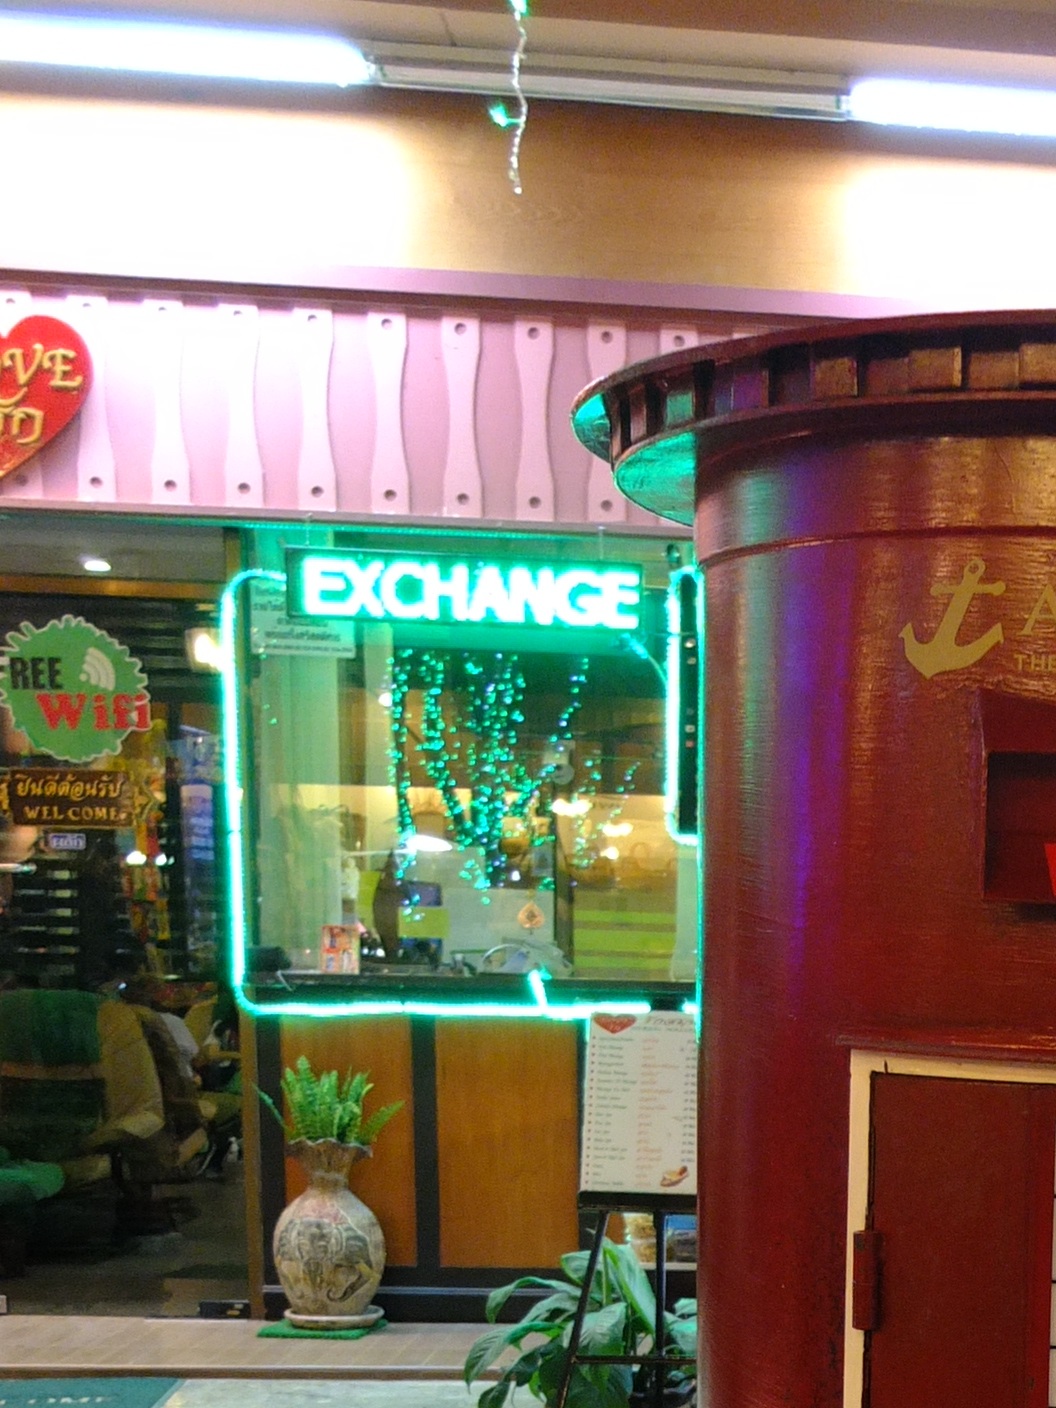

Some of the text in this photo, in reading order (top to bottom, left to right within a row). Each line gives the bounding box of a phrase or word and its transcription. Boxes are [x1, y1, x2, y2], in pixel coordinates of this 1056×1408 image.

[0, 343, 84, 389] VE
[301, 555, 640, 630] EXCHANGE
[0, 656, 64, 691] REE
[35, 692, 151, 731] Wifi
